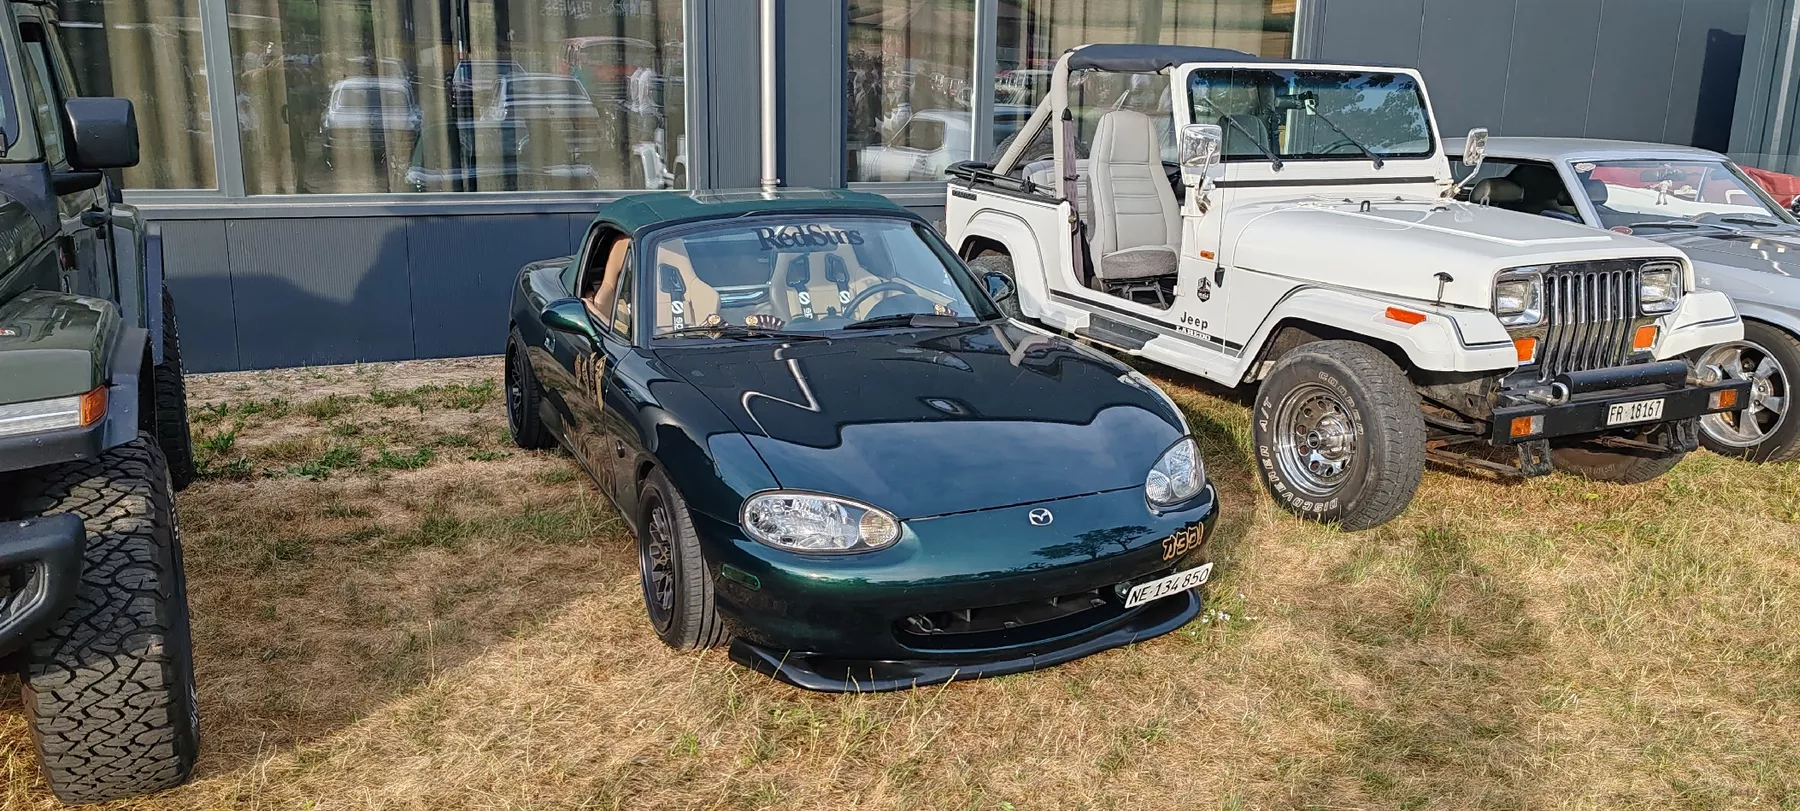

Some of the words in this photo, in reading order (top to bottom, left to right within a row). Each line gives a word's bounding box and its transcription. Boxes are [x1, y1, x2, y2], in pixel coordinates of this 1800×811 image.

[751, 224, 865, 251] RedSuns
[1176, 324, 1212, 341] LAREDO
[1180, 311, 1208, 331] Jeep
[1259, 396, 1272, 432] A/T
[1318, 371, 1364, 435] COOPER
[1259, 445, 1339, 513] DISCOVERER
[1181, 568, 1210, 589] 850
